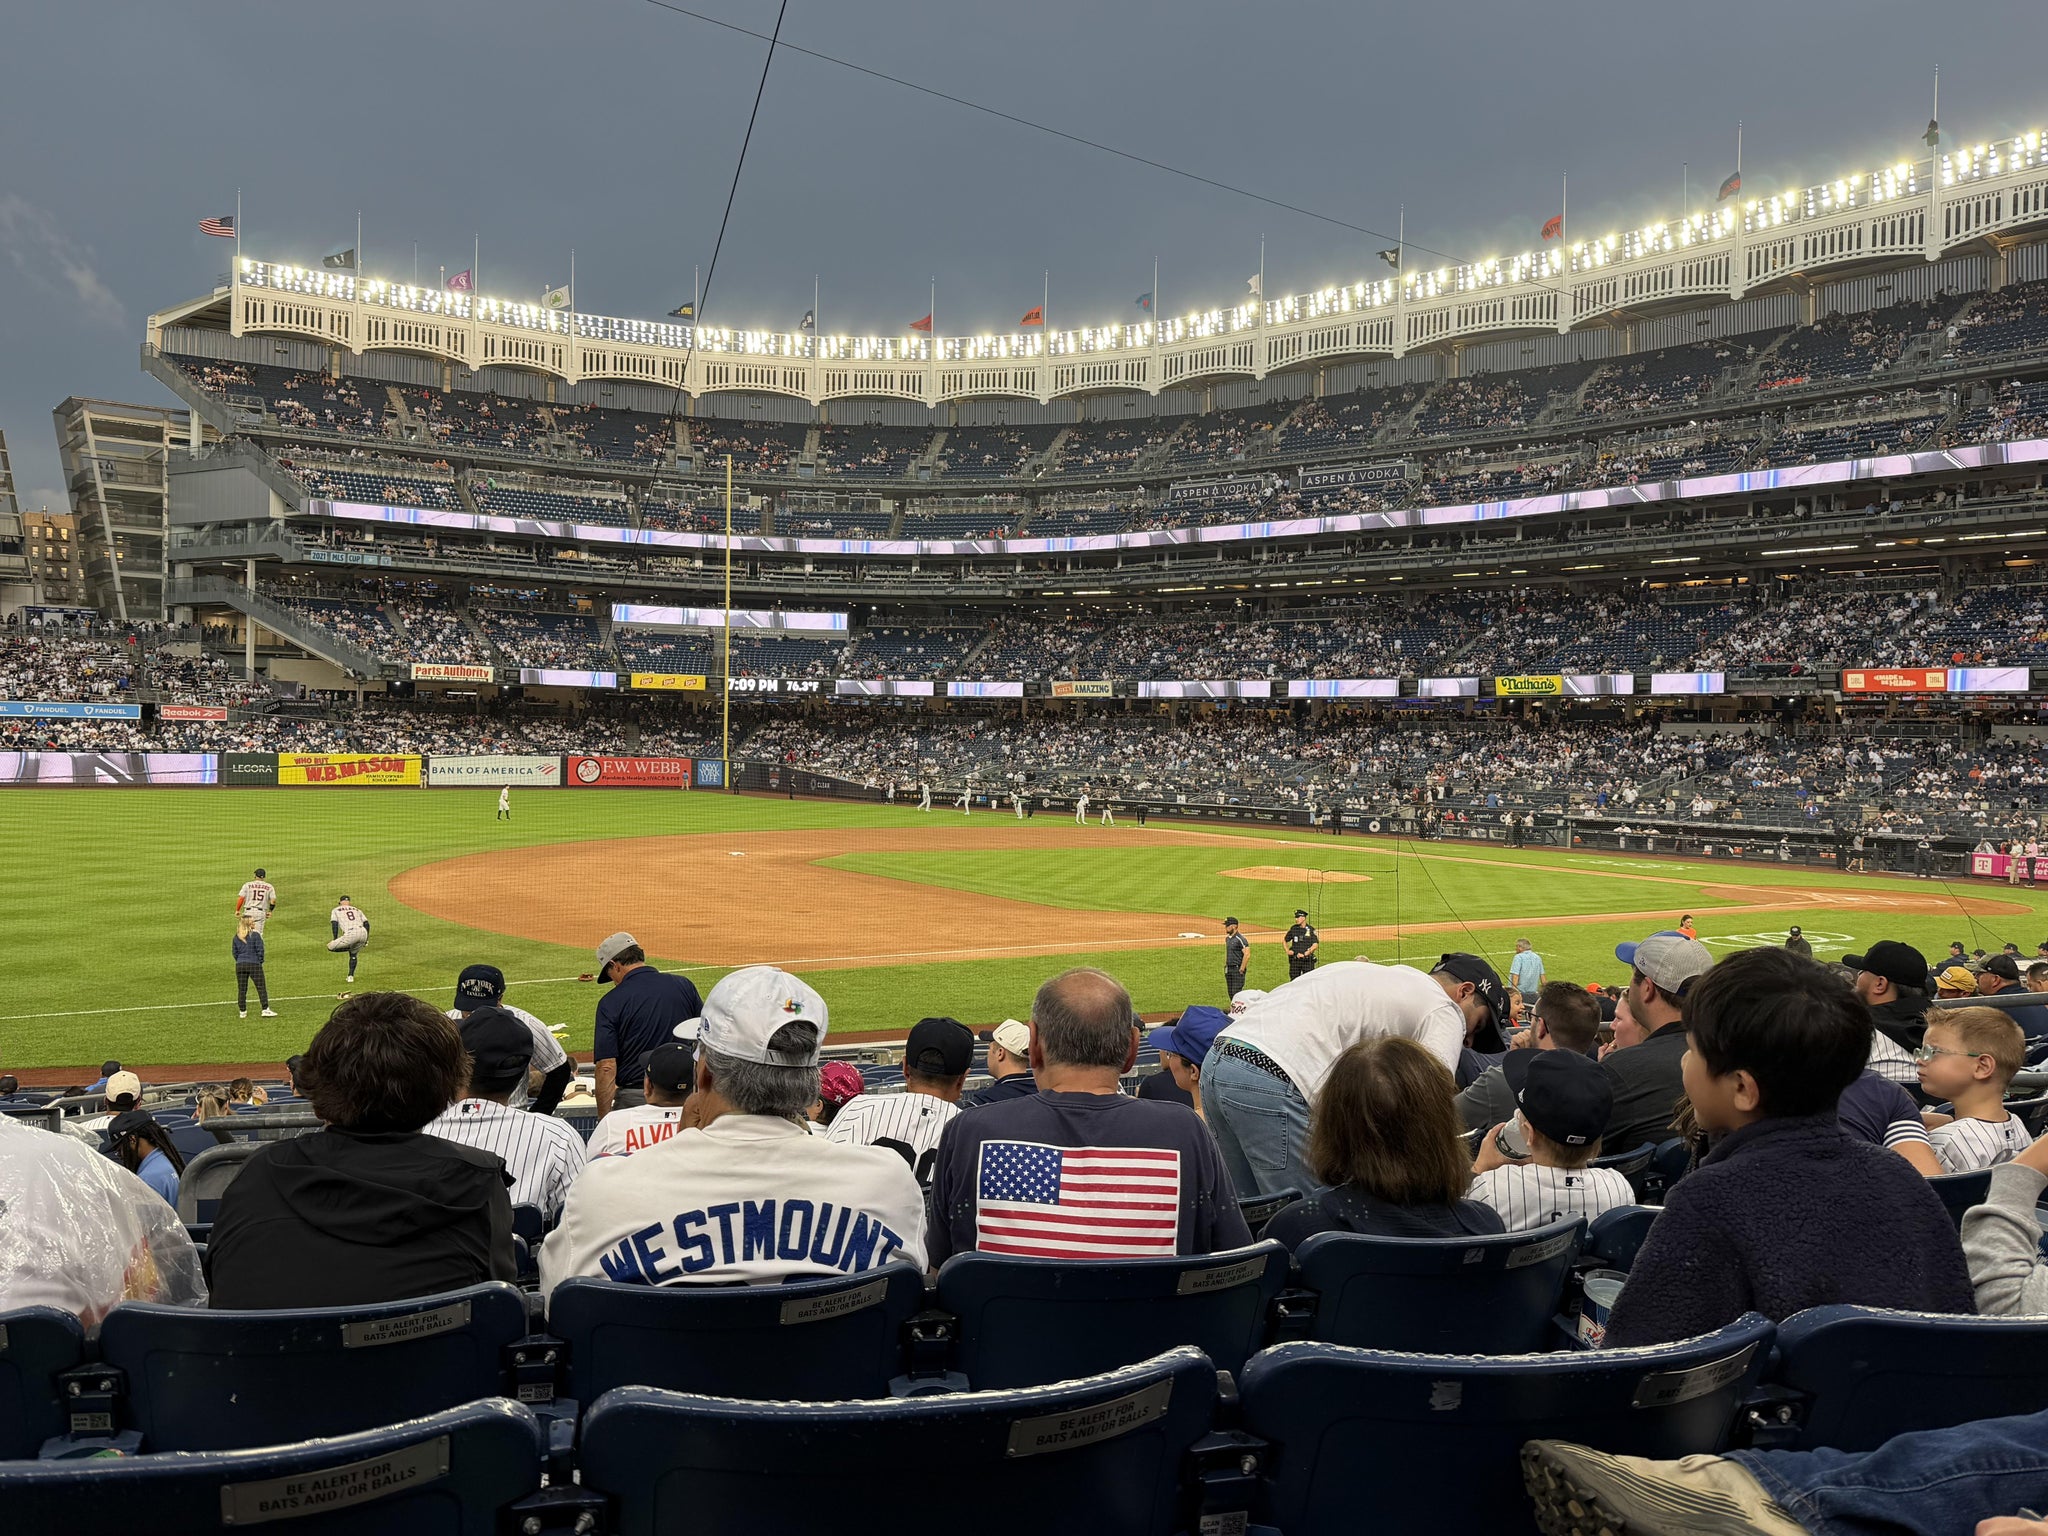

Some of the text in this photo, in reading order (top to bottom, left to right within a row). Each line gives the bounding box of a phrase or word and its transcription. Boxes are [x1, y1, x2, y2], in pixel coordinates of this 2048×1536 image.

[1306, 469, 1399, 486] ASPEN VODKA
[1175, 483, 1257, 499] ASPEN VODKA
[312, 552, 361, 563] 2021 MLS CUP
[415, 666, 441, 676] Parts
[443, 666, 489, 678] Authority
[728, 679, 778, 692] 7:09 PM
[786, 681, 819, 692] 76.3°F
[1075, 685, 1109, 693] AMAZING
[1501, 678, 1556, 692] Nathan's
[164, 709, 200, 717] Reebok
[294, 757, 311, 765] WHO
[342, 756, 406, 779] MASON
[603, 761, 680, 774] F.W. WEBB
[466, 767, 480, 775] OF
[483, 767, 533, 775] AMERICA
[252, 890, 265, 901] 15
[346, 911, 355, 921] 8
[461, 979, 494, 996] NEW YORK
[600, 1199, 904, 1285] WESTMOUNT
[798, 1294, 872, 1318] BATS AND/OR BALLS
[812, 1292, 862, 1309] BE ALERT FOR
[363, 1317, 453, 1341] BATS AND/OR BALLS
[379, 1314, 438, 1332] BE ALERT FOR
[1060, 1401, 1135, 1431] BE ALERT FOR
[1036, 1406, 1149, 1446] BATS AND/OR BALLS
[286, 1463, 392, 1496] BE ALERT FOR
[259, 1466, 417, 1512] BATS AND/OR BALLS
